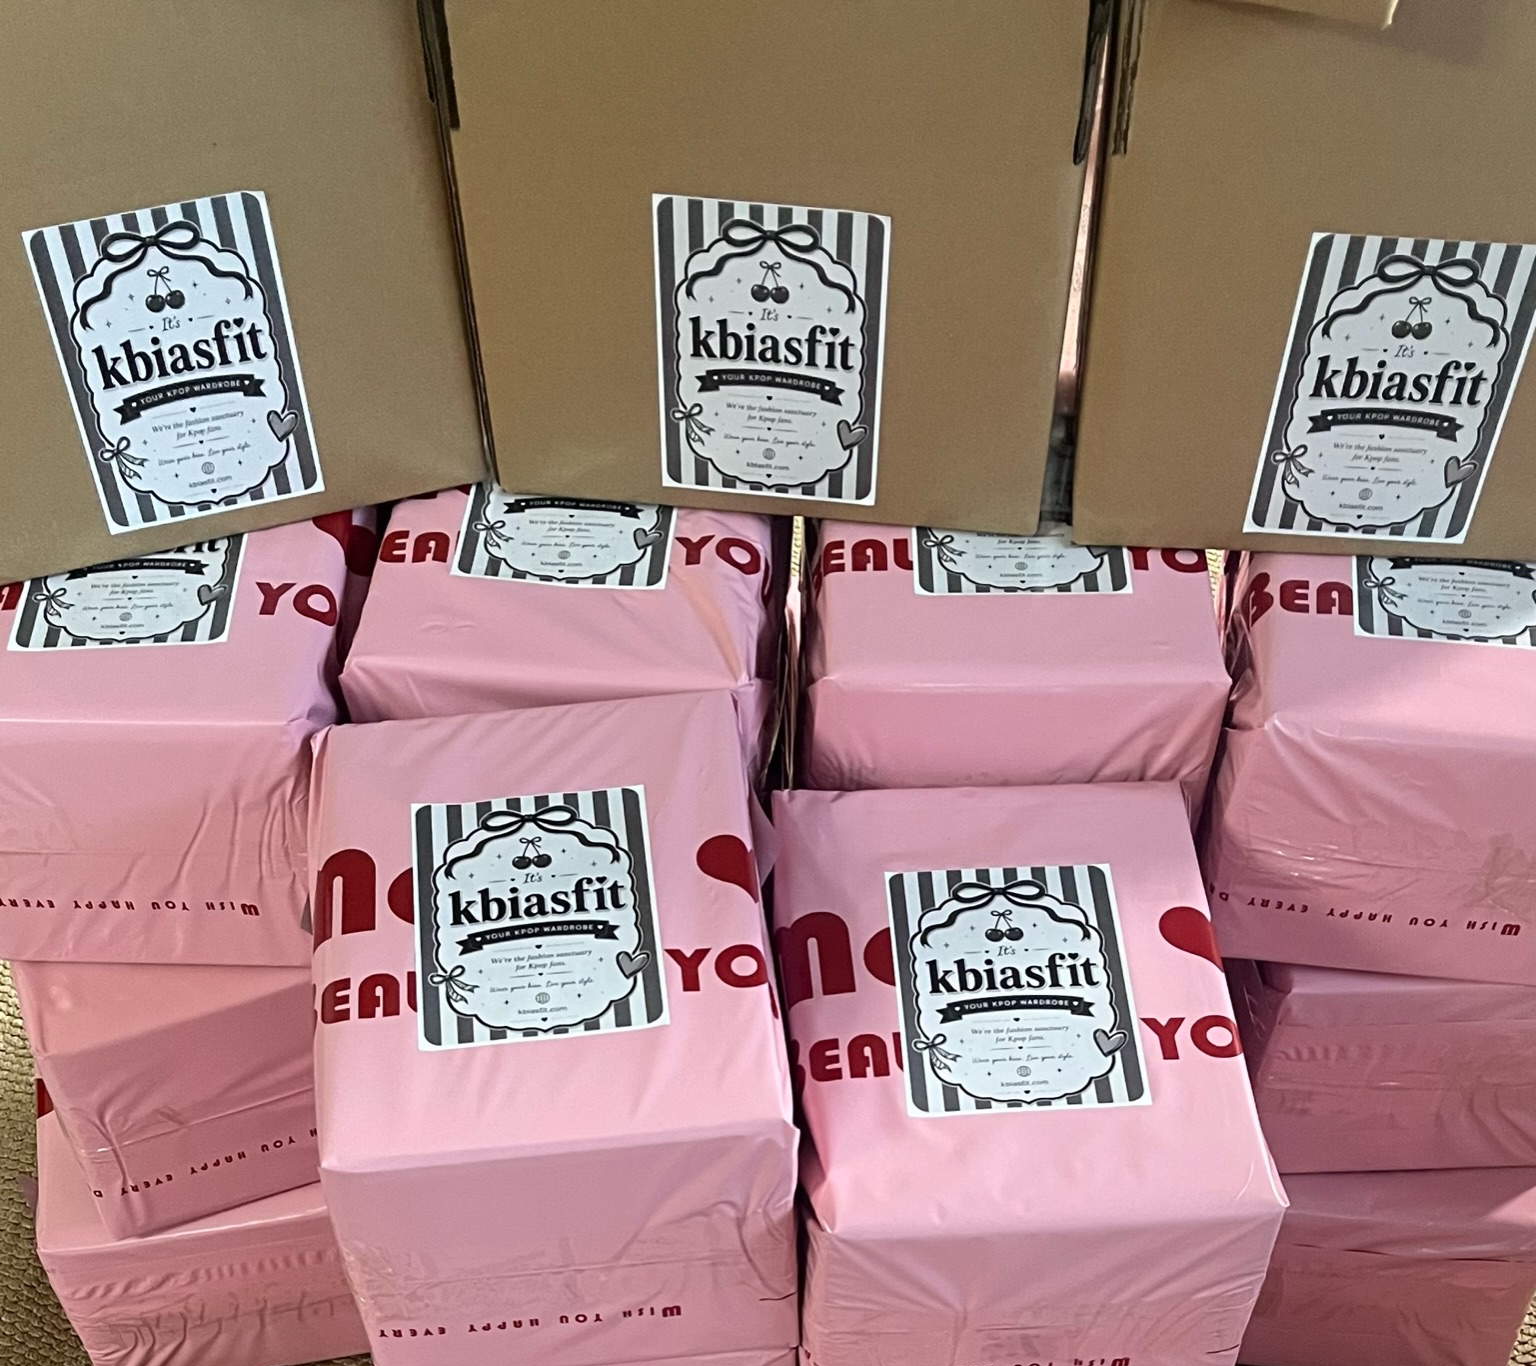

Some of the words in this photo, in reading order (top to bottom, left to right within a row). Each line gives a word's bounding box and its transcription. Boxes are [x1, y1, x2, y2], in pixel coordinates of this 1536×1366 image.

[759, 307, 779, 321] It's
[162, 314, 181, 331] It's
[688, 315, 855, 370] kbiasfit
[91, 316, 268, 390] kbiasfit
[1393, 344, 1415, 358] It's
[1308, 354, 1488, 406] kbiasfit
[139, 391, 164, 405] YOUR
[165, 385, 192, 397] KPOP
[192, 379, 241, 392] WARDROBE
[1337, 412, 1362, 420] YOUR
[1364, 412, 1391, 420] KPOP
[1391, 414, 1441, 427] WARDROBE
[188, 475, 232, 488] kbiasfit.com
[675, 534, 761, 576] YO
[523, 871, 543, 883] It's
[74, 901, 134, 910] HAPPY
[152, 901, 189, 911] YOU
[448, 875, 626, 926] kbiasfit
[1248, 898, 1308, 913] EVERY
[206, 902, 259, 916] WISH
[1327, 908, 1392, 922] HAPPY
[1409, 917, 1447, 927] YOU
[1467, 921, 1520, 936] WISH
[485, 930, 512, 940] YOUR
[513, 926, 540, 935] KPOP
[542, 923, 593, 932] WARDROBE
[997, 944, 1016, 956] It's
[925, 952, 1100, 994] kbiasfit
[963, 1001, 989, 1010] YOUR
[991, 999, 1018, 1007] KPOP
[1019, 998, 1069, 1006] WARDROBE
[261, 1136, 295, 1152] YOU
[191, 1152, 246, 1174] HAPPY
[121, 1175, 172, 1195] EVERY
[560, 1314, 602, 1323] YOU
[623, 1306, 681, 1317] WISH
[380, 1327, 445, 1337] EVERY
[469, 1319, 539, 1332] HAPPY
